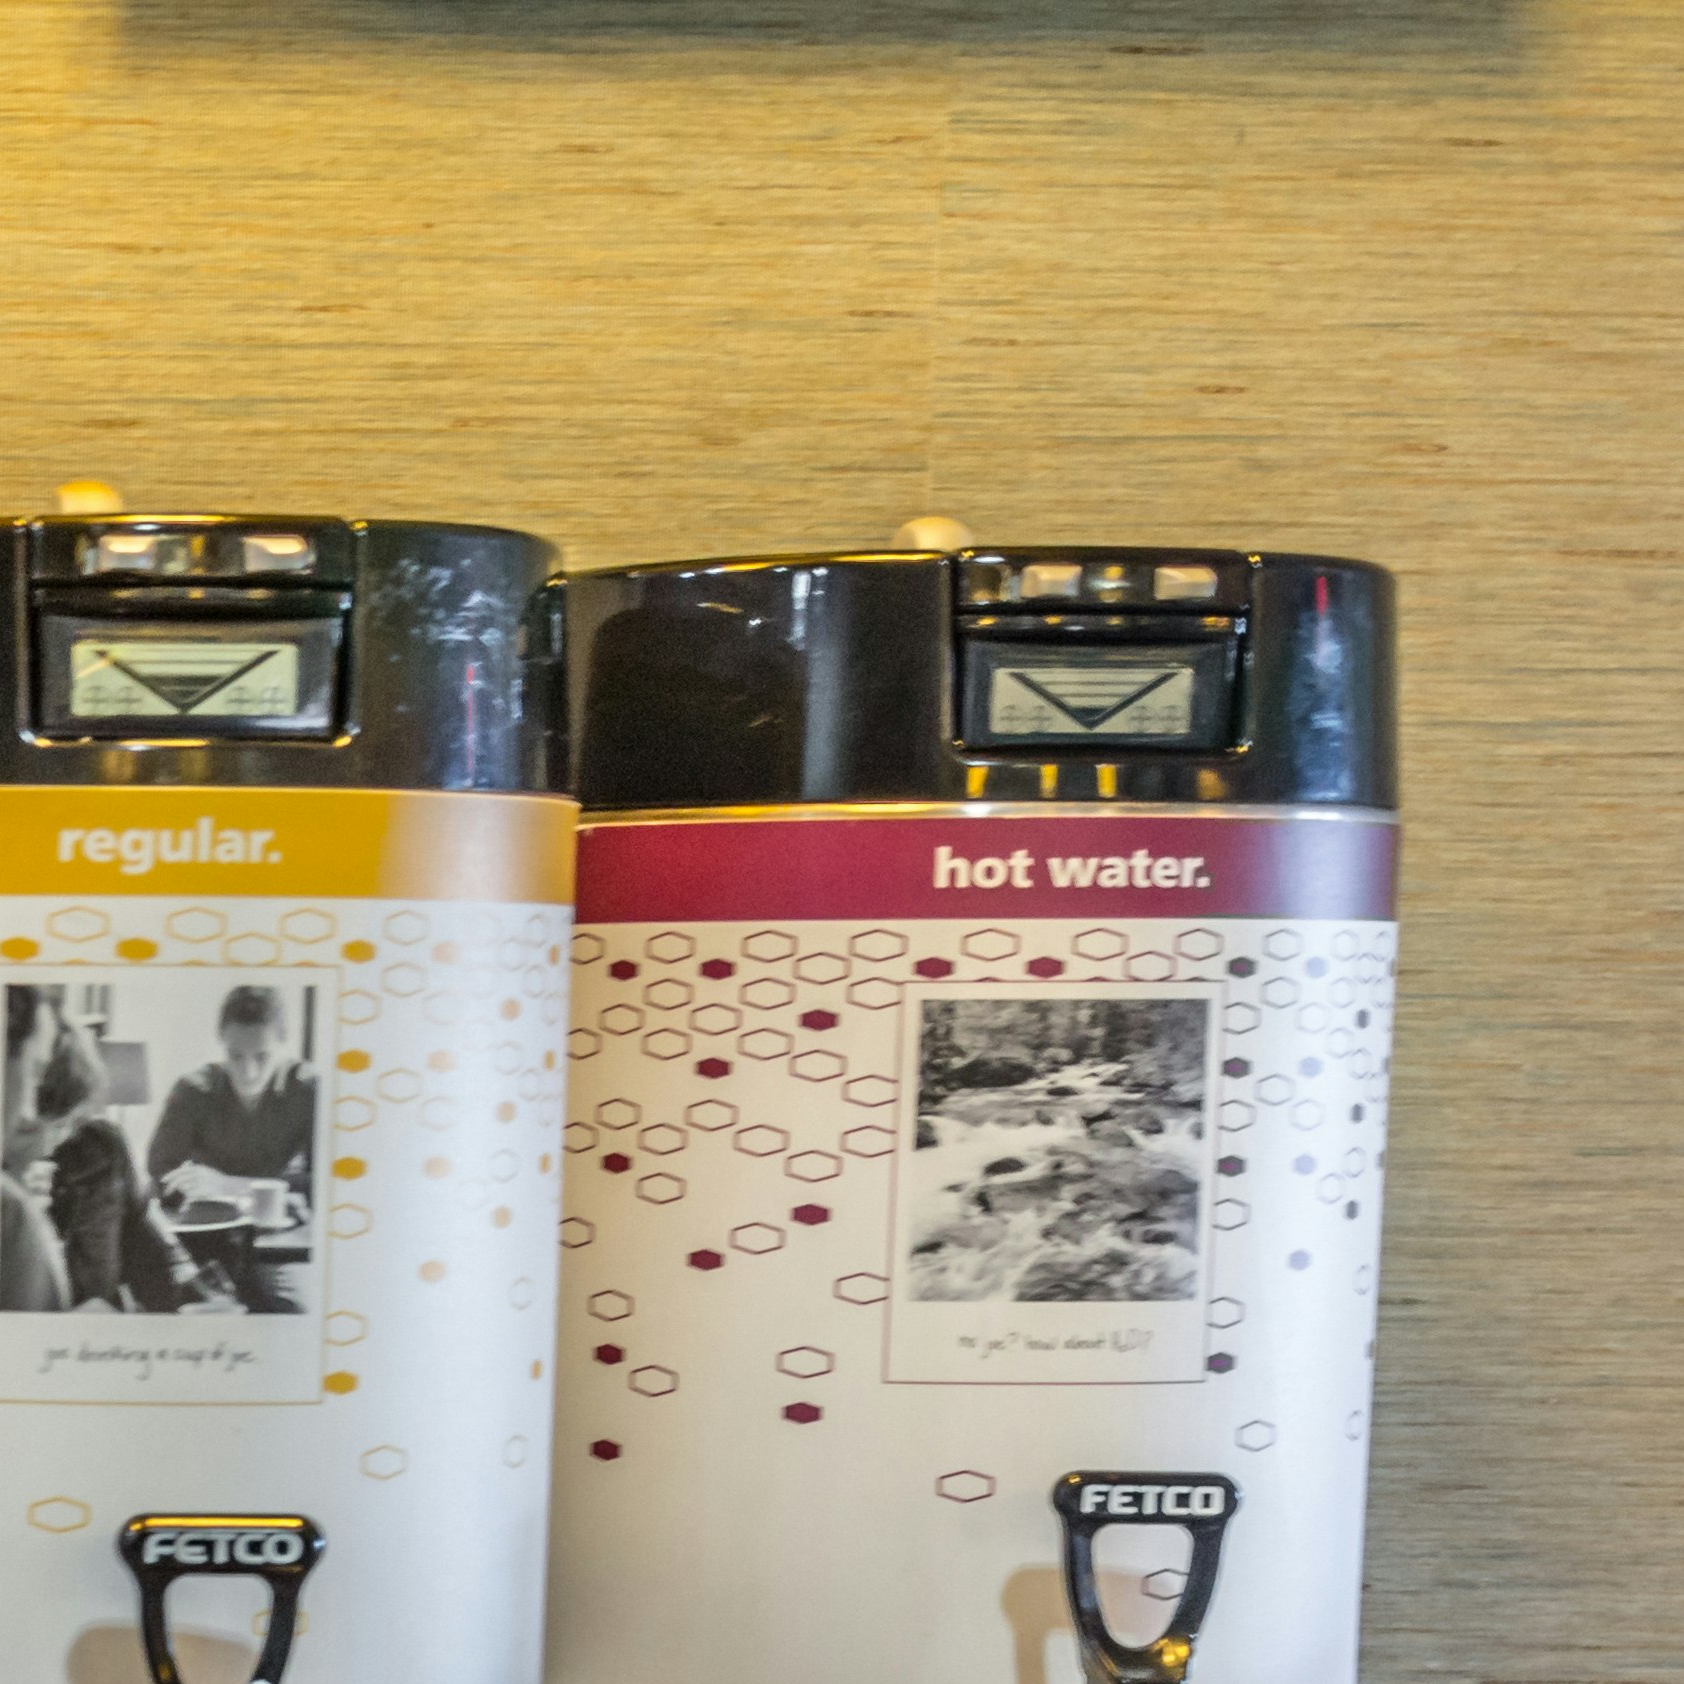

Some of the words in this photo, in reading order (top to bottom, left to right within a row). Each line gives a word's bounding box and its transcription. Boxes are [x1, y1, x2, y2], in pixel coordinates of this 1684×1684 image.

[57, 815, 282, 875] regular.
[933, 846, 1034, 888] hot
[1046, 848, 1211, 888] water.
[1080, 1484, 1225, 1516] FETCO
[142, 1532, 304, 1565] FETCO
